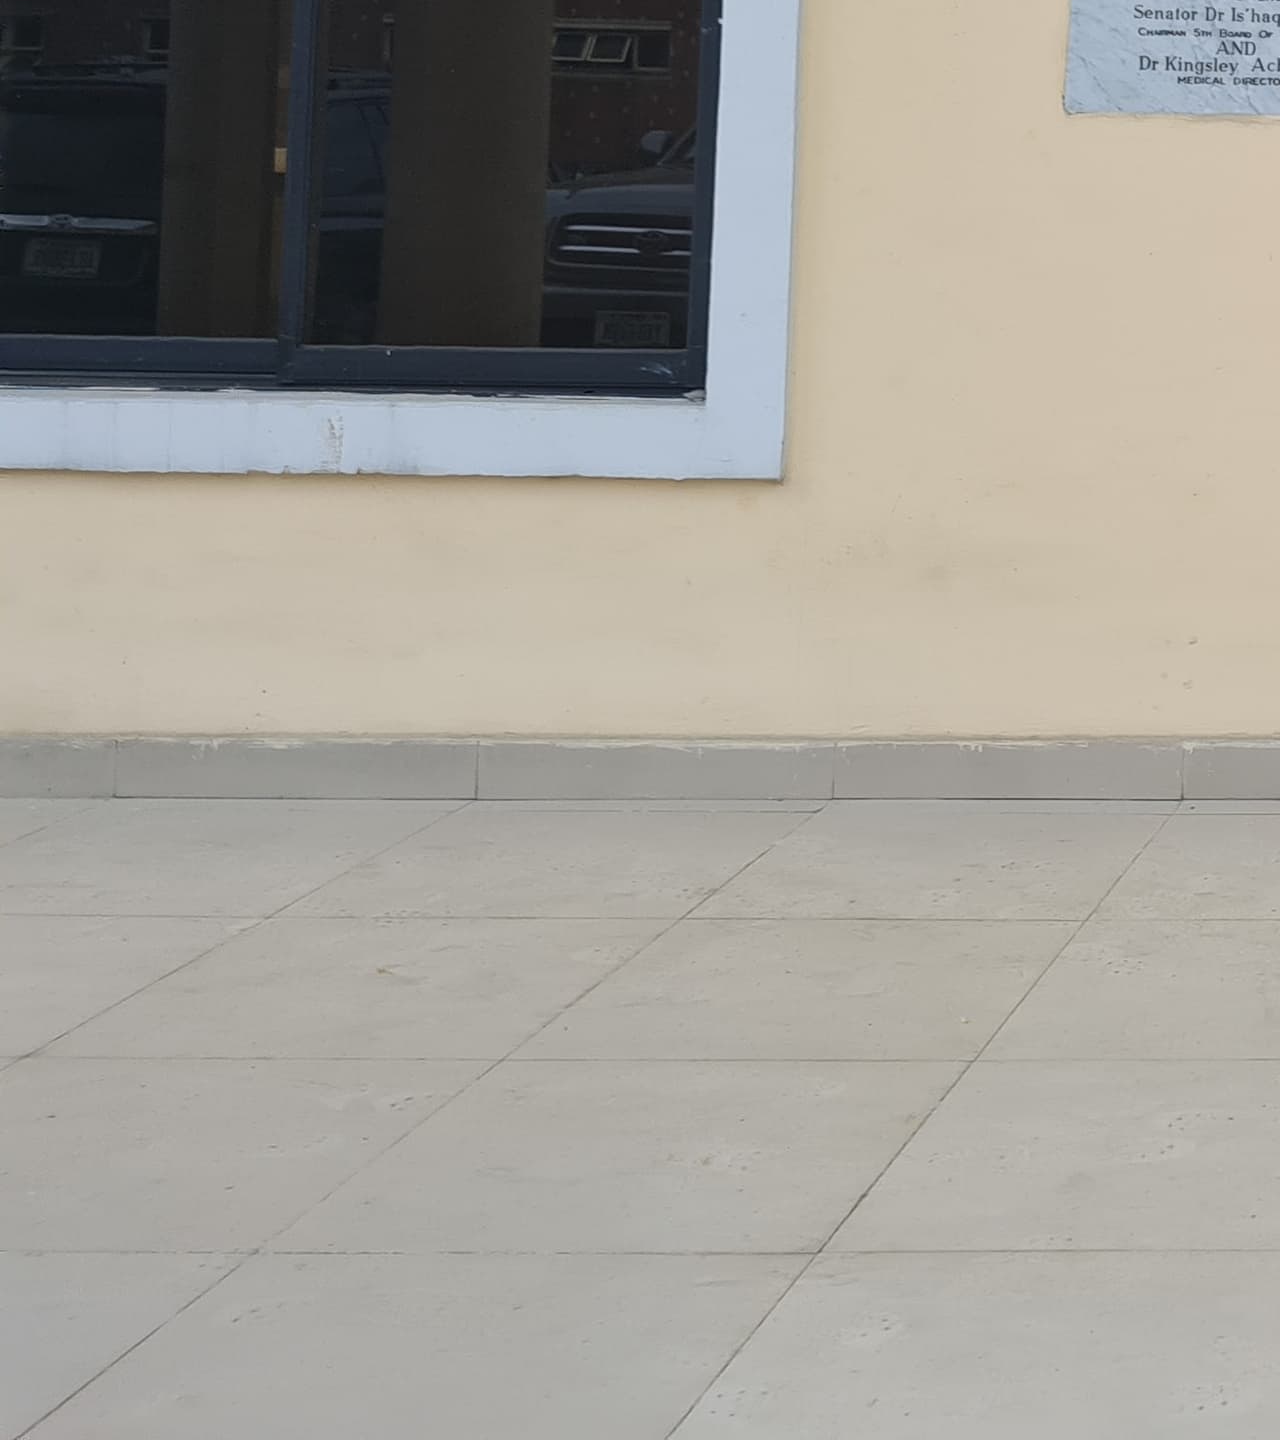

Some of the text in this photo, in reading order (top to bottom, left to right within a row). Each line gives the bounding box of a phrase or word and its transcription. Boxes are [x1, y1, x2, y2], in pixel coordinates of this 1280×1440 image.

[1134, 5, 1198, 21] Senator
[1205, 7, 1224, 21] Dr
[1216, 41, 1256, 55] AND
[1139, 55, 1159, 71] Dr
[1165, 56, 1239, 76] Kingsley
[1177, 77, 1225, 85] MEDICAL
